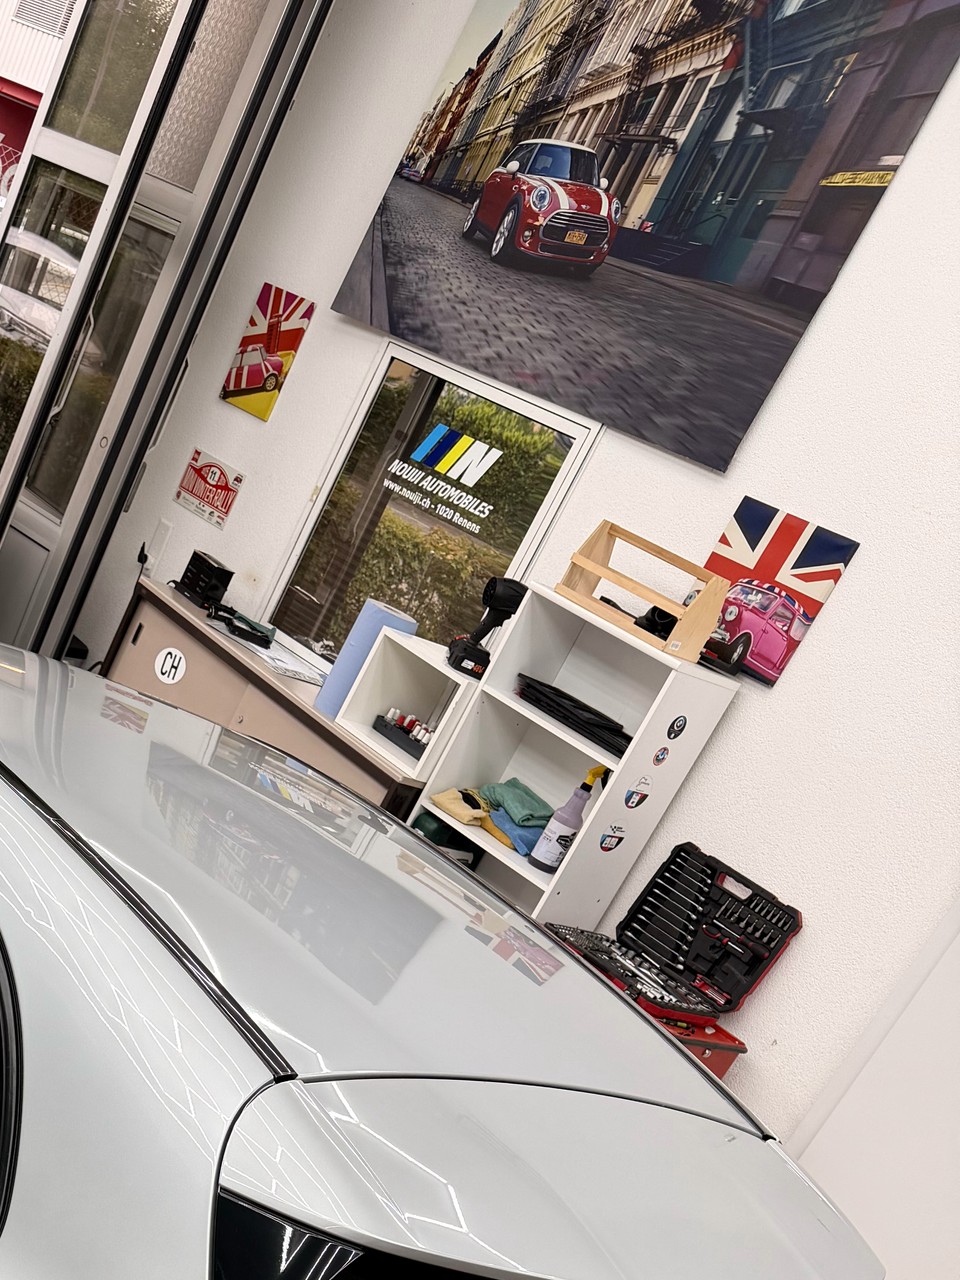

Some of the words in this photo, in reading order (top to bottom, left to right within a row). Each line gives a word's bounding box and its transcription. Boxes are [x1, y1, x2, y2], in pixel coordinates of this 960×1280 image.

[212, 489, 237, 514] RALLY
[383, 478, 430, 508] www.nouiji.ch
[435, 503, 454, 520] 1020
[452, 513, 481, 534] Renens
[387, 458, 426, 485] NOUIJI
[419, 475, 494, 518] AUTOMOBILES
[160, 651, 182, 680] CH
